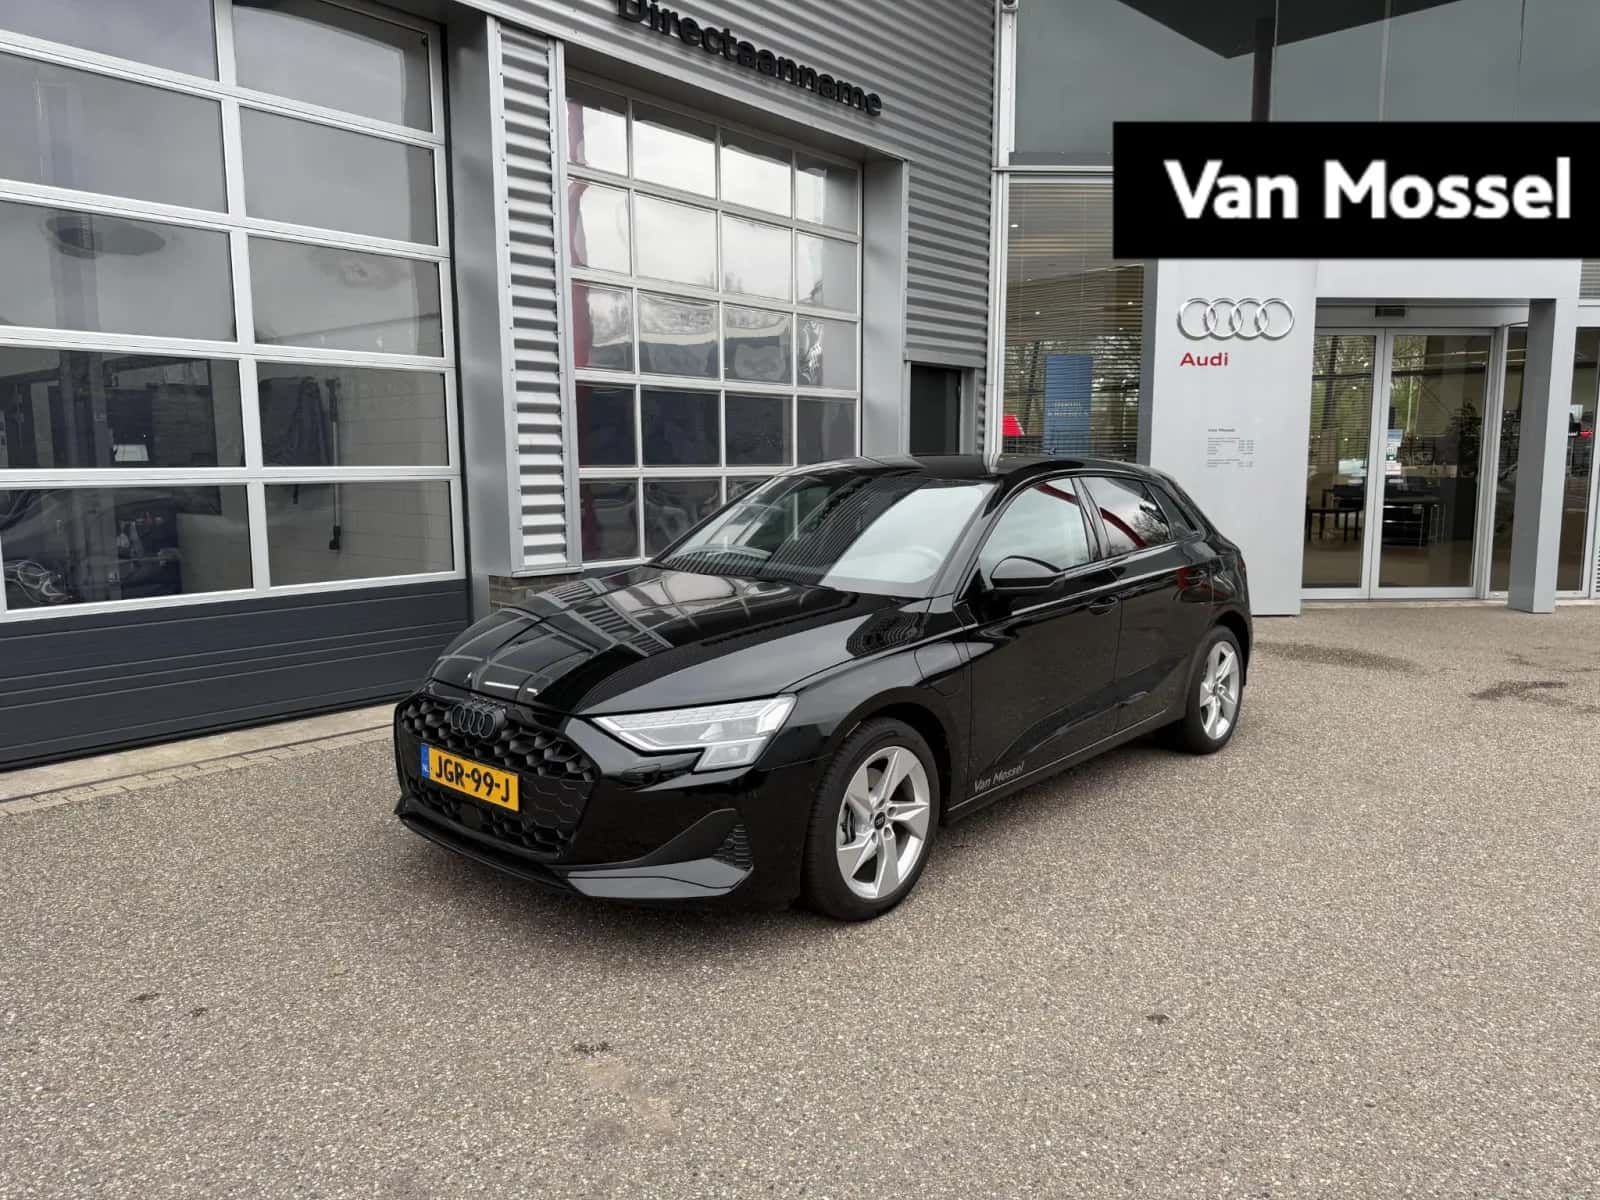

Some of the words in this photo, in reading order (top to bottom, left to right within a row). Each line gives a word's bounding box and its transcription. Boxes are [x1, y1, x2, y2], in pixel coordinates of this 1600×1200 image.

[617, 0, 882, 117] Directaanname
[1180, 352, 1229, 366] Audi
[435, 755, 510, 803] JGR-99-J
